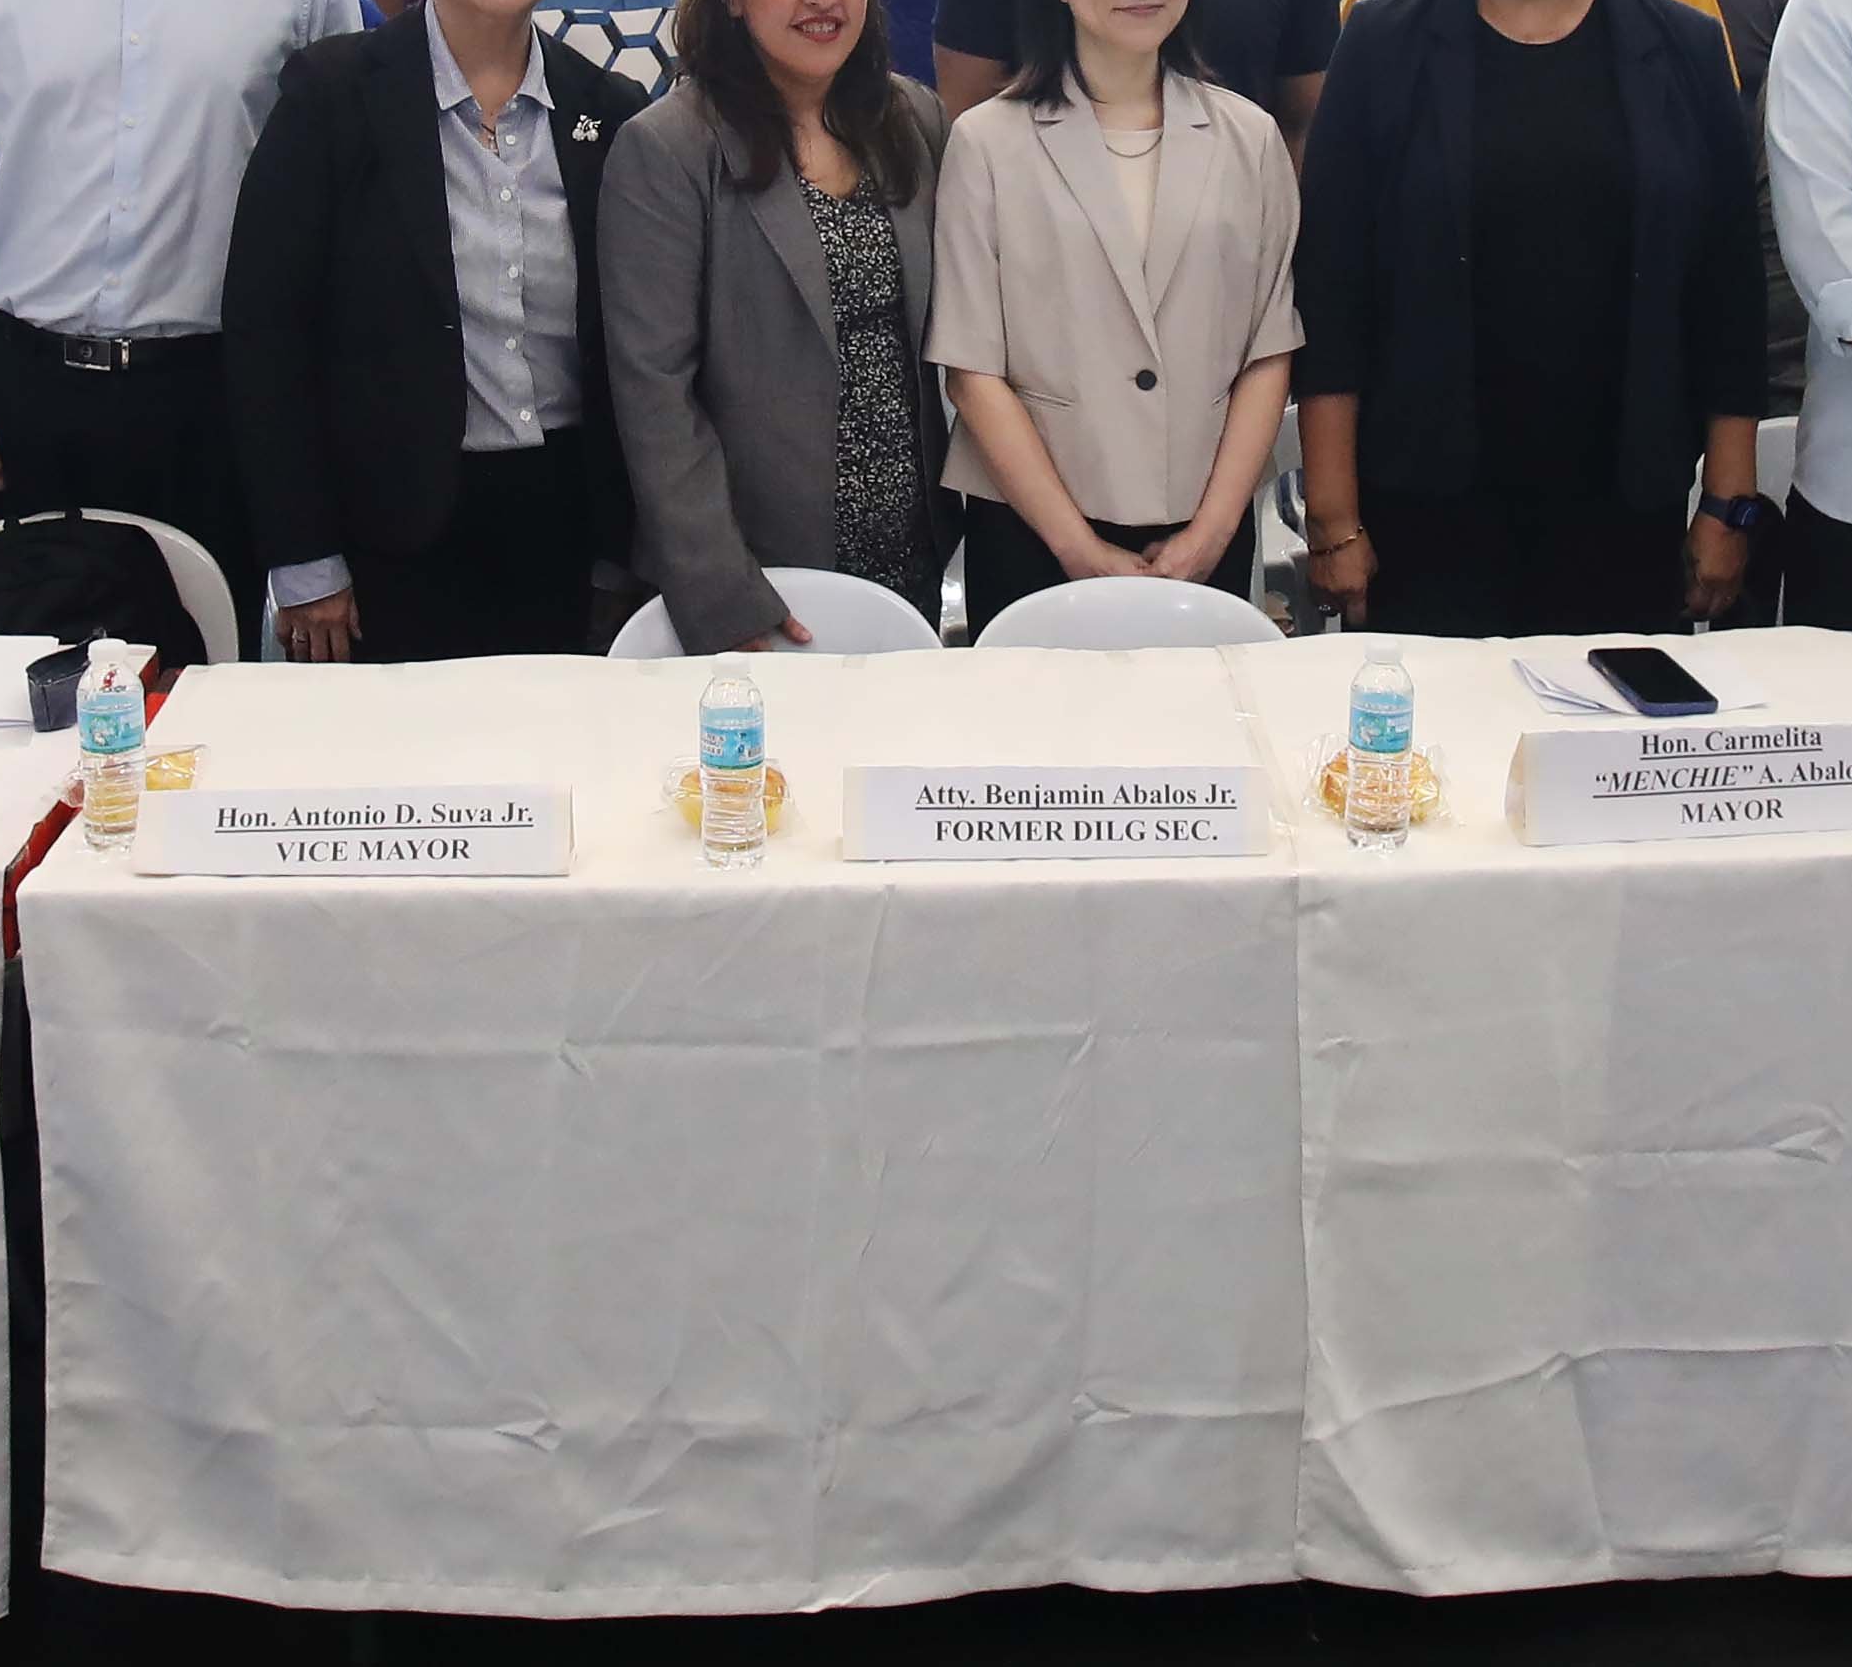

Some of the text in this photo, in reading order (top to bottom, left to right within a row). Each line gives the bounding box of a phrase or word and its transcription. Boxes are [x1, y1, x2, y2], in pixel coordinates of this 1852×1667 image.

[1640, 727, 1822, 755] Hon. Carmelita
[1759, 762, 1785, 784] A.
[915, 782, 1237, 809] Atty. Benjamin Abalos Jr.
[215, 801, 534, 829] Hon. Antonio D. Suva Jr.
[1680, 799, 1784, 824] MAYOR
[934, 819, 1218, 842] FORMER DILG SEC.
[275, 839, 471, 863] VICE MAYOR
